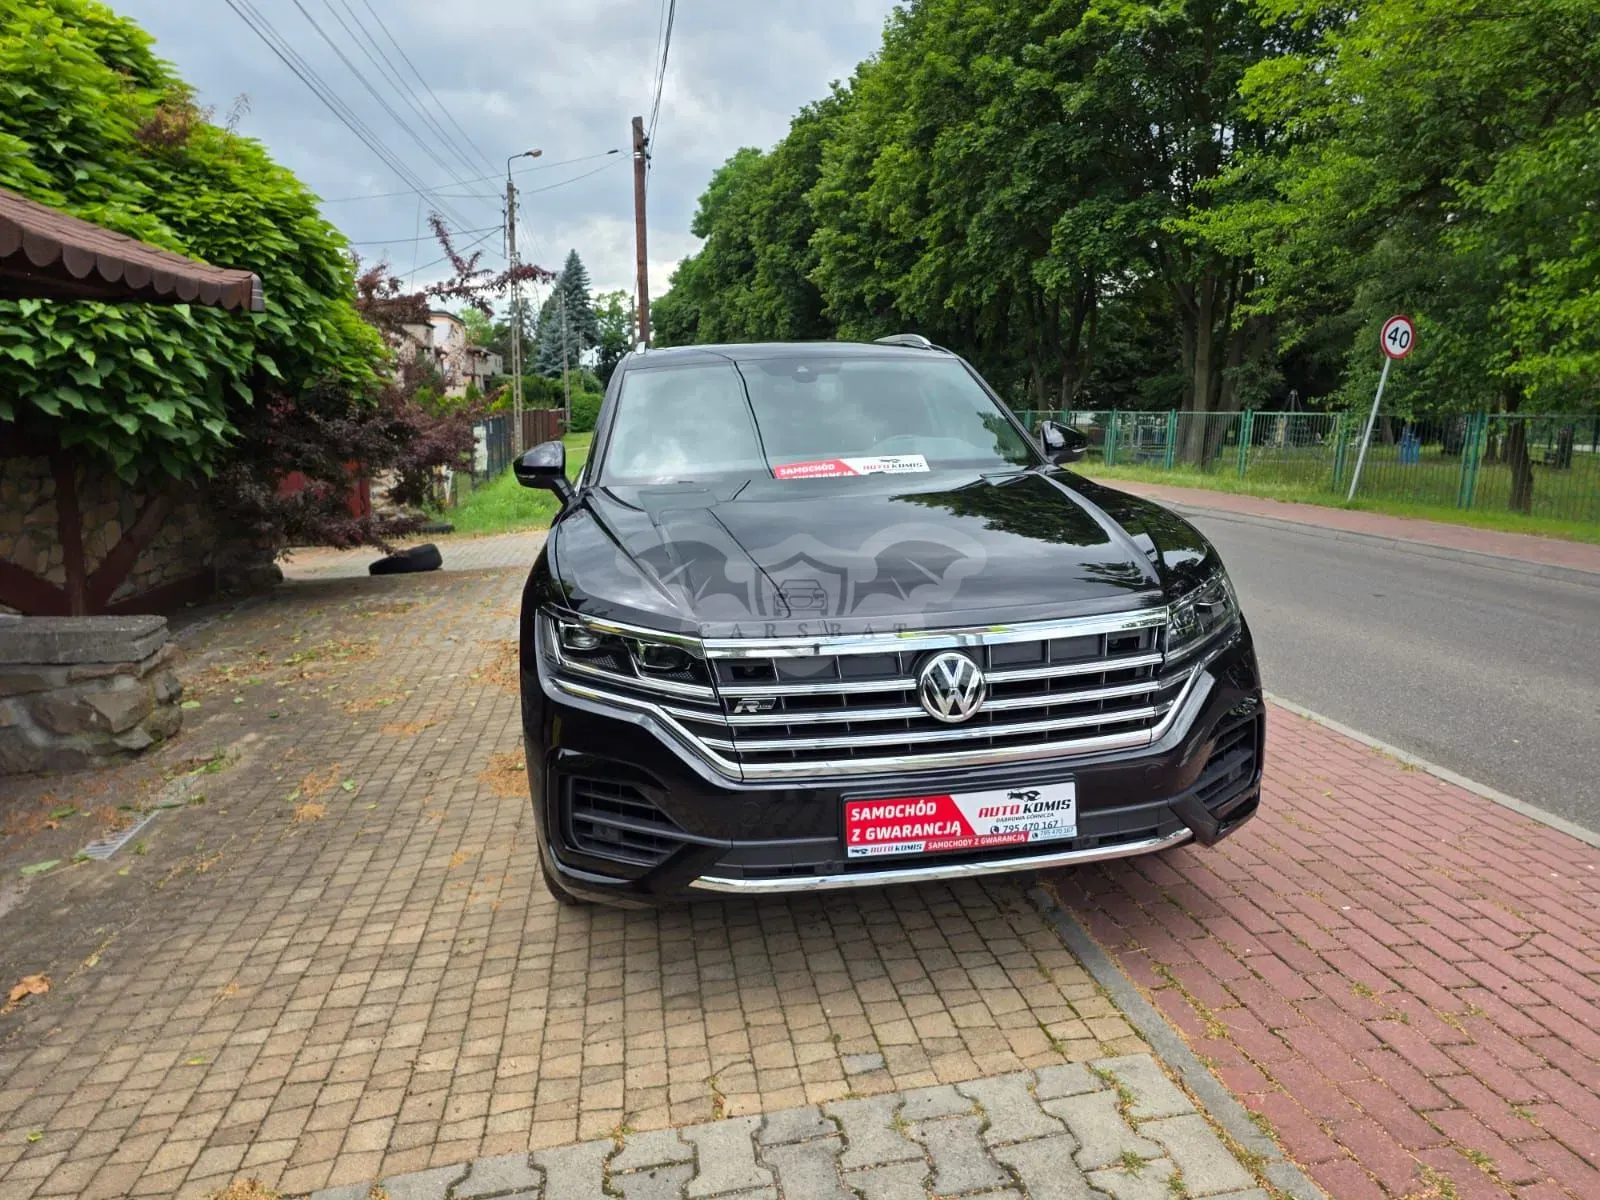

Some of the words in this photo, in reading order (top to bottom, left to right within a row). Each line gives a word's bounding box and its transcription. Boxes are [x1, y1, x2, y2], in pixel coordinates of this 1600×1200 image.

[1387, 326, 1410, 349] 40
[850, 799, 937, 821] SAMOCHÓD
[978, 804, 1020, 818] AUTO
[1023, 799, 1072, 814] KOMIS
[851, 828, 861, 842] Z
[865, 820, 962, 840] GWARANCJĄ
[1003, 824, 1020, 833] 795
[1022, 822, 1039, 831] 470
[1043, 820, 1058, 829] 167
[927, 839, 972, 849] SAMOCHODY
